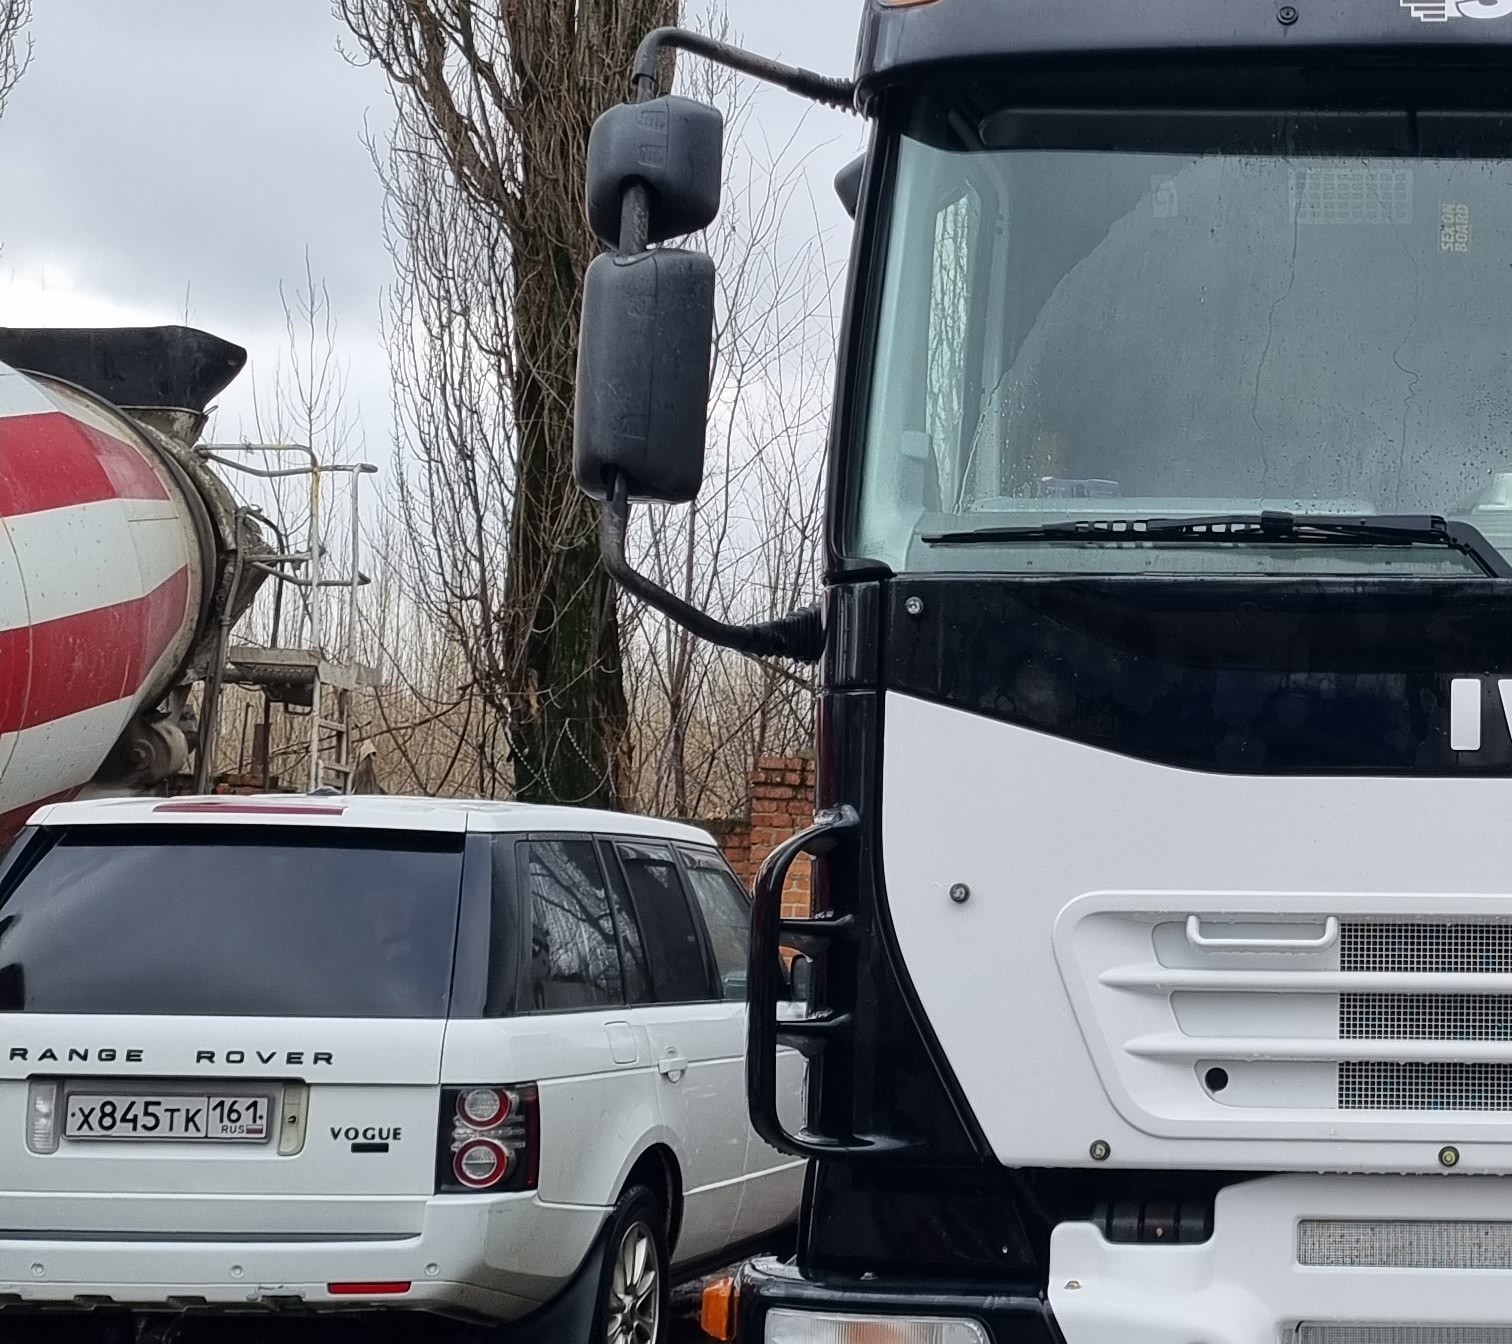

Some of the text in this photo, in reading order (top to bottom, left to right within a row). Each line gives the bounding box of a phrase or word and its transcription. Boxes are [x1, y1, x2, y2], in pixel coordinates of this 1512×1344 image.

[1454, 204, 1469, 252] BOARD
[8, 1046, 335, 1066] RANGE ROVER
[211, 1099, 260, 1124] 161
[221, 1123, 245, 1135] RUS
[330, 1126, 402, 1141] VOGUE
